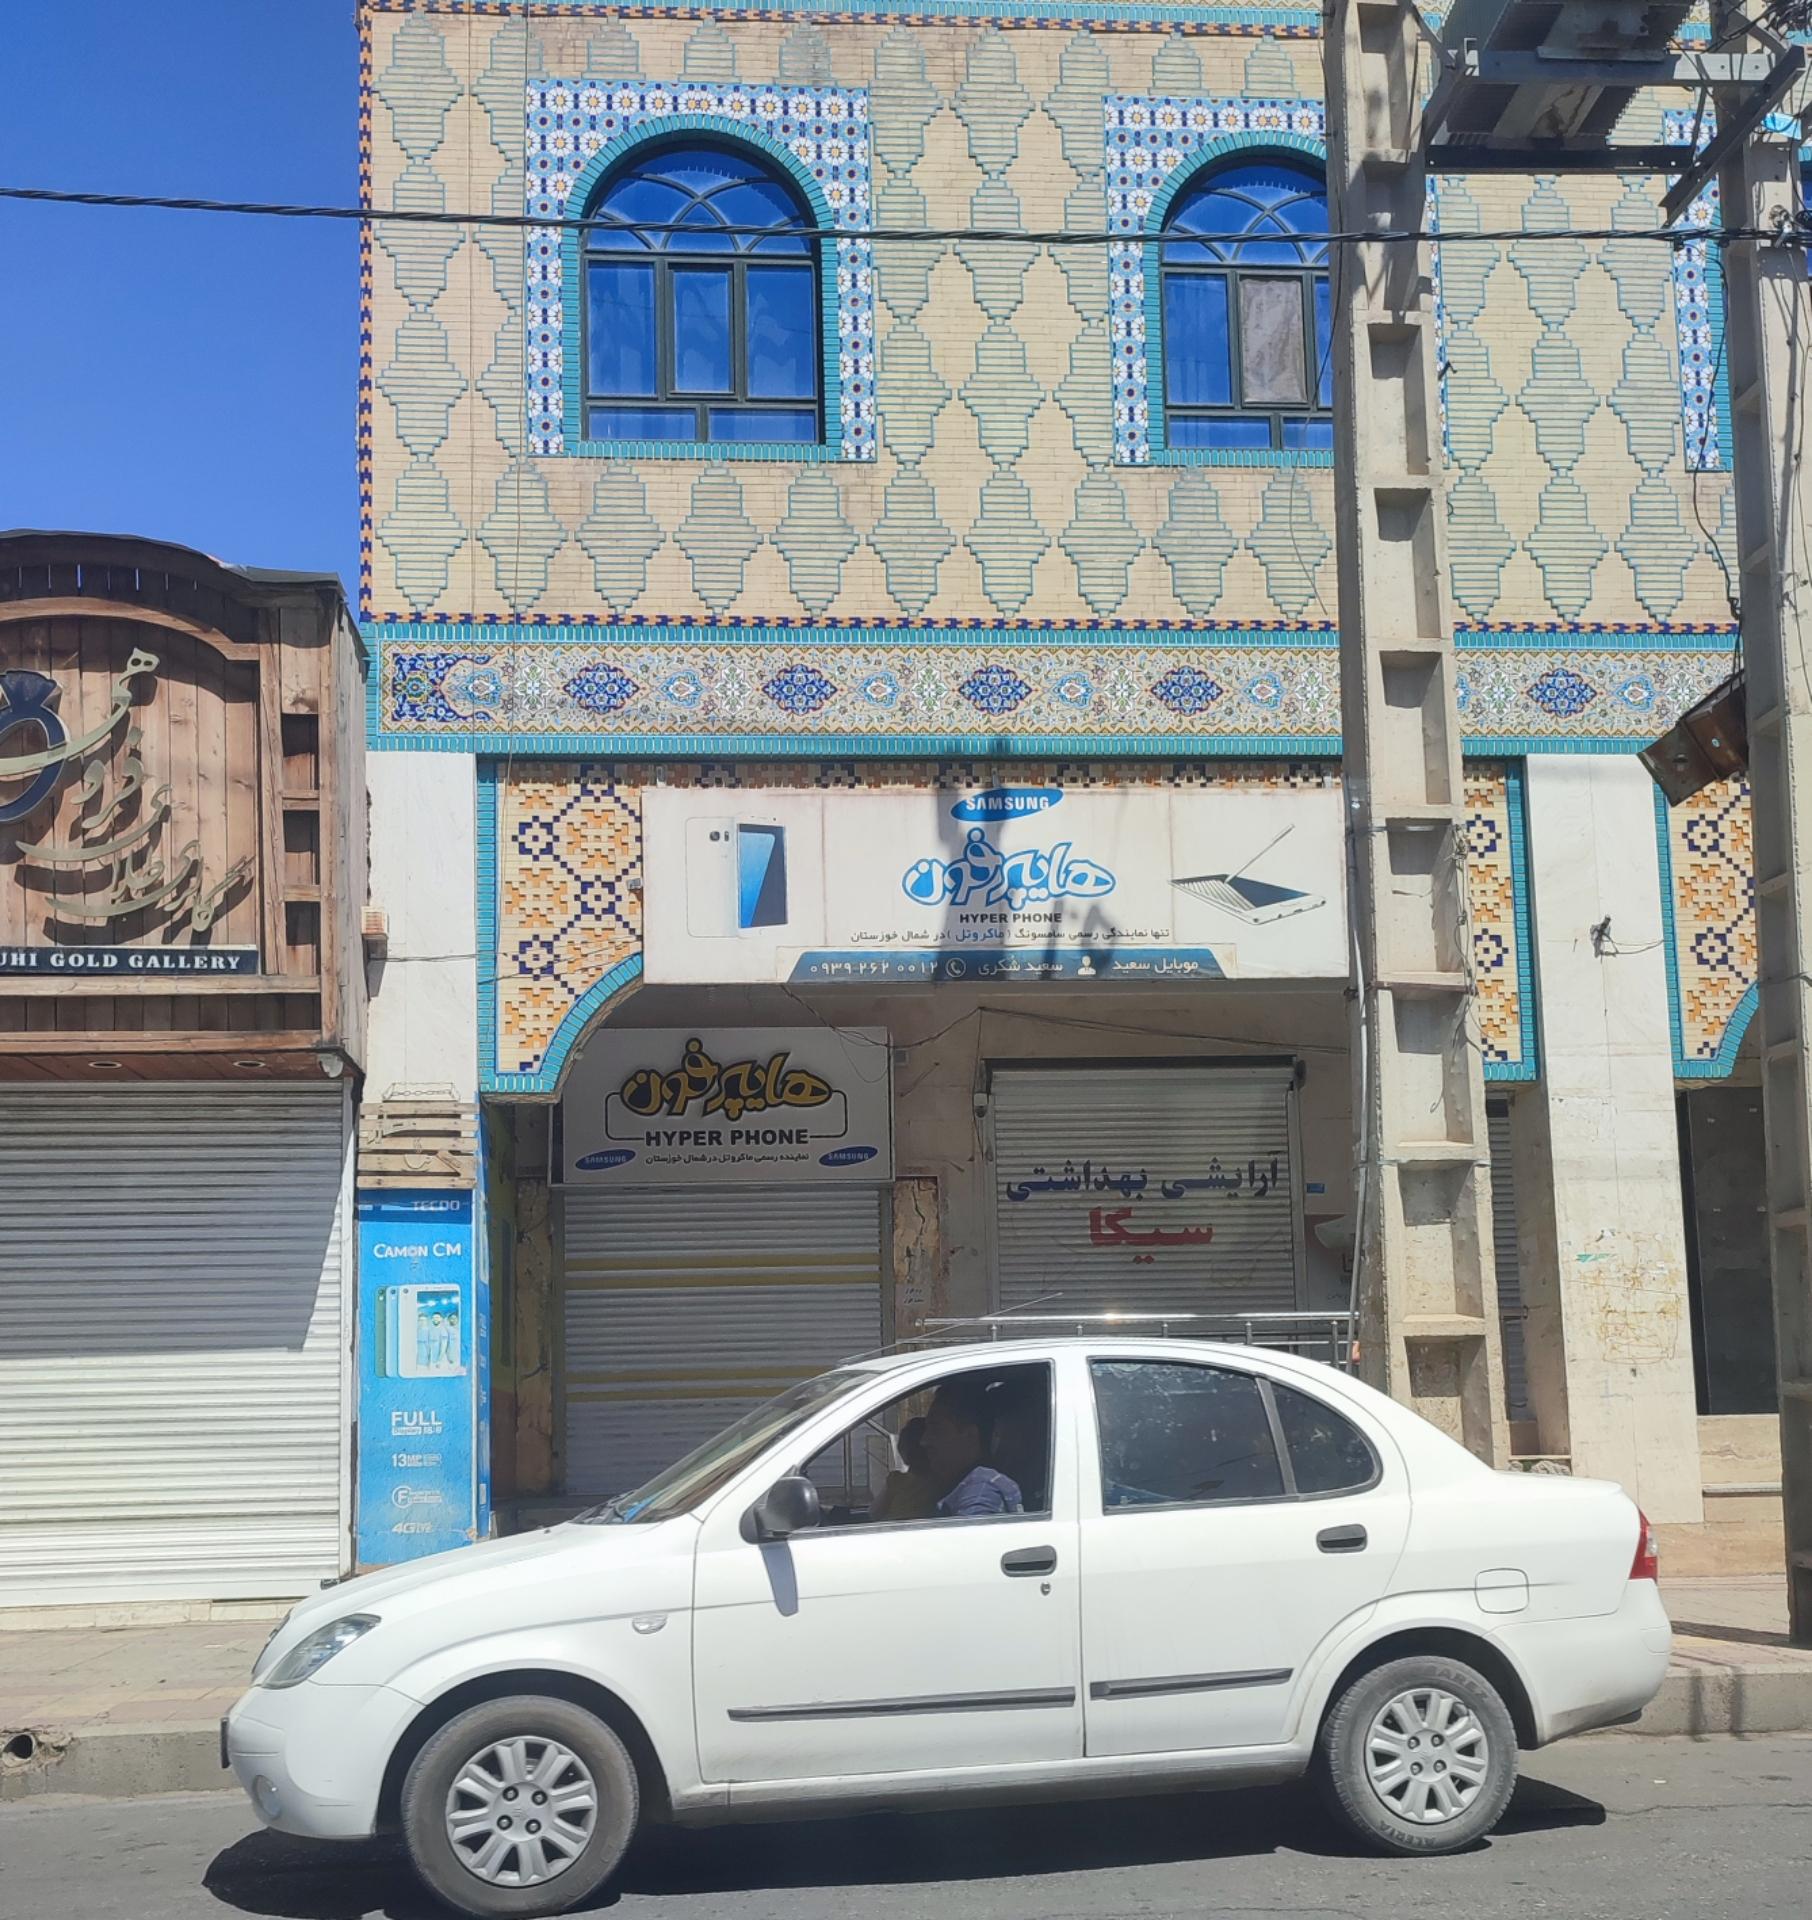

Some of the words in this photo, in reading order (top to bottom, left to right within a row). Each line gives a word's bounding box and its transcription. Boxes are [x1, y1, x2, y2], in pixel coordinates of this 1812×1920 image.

[965, 796, 1050, 811] SAMSUNG
[959, 912, 1008, 924] HYPER
[1012, 912, 1063, 924] PHONE
[850, 928, 899, 943] خوزستان
[901, 926, 930, 942] شمال
[1014, 927, 1065, 942] سامسونگ
[1068, 929, 1099, 943] رسمی
[1101, 926, 1149, 942] نمایندگی
[1150, 927, 1170, 941] تنها
[50, 952, 118, 968] GOLD
[128, 953, 241, 970] GALLERY
[1024, 958, 1064, 975] سعید
[1111, 958, 1150, 972] سعید
[1154, 957, 1199, 974] موبایل
[645, 1130, 723, 1147] HYPER
[730, 1129, 809, 1146] PHONE
[584, 1153, 627, 1165] SAMSUNG
[645, 1152, 683, 1165] خوزستان
[683, 1152, 707, 1165] شمال
[753, 1152, 779, 1164] رسمی
[779, 1152, 809, 1162] نماینده
[828, 1152, 869, 1161] SAMSUNG
[1005, 1159, 1149, 1201] بهداشتی
[433, 1242, 462, 1257] CM
[391, 1410, 442, 1426] FULL
